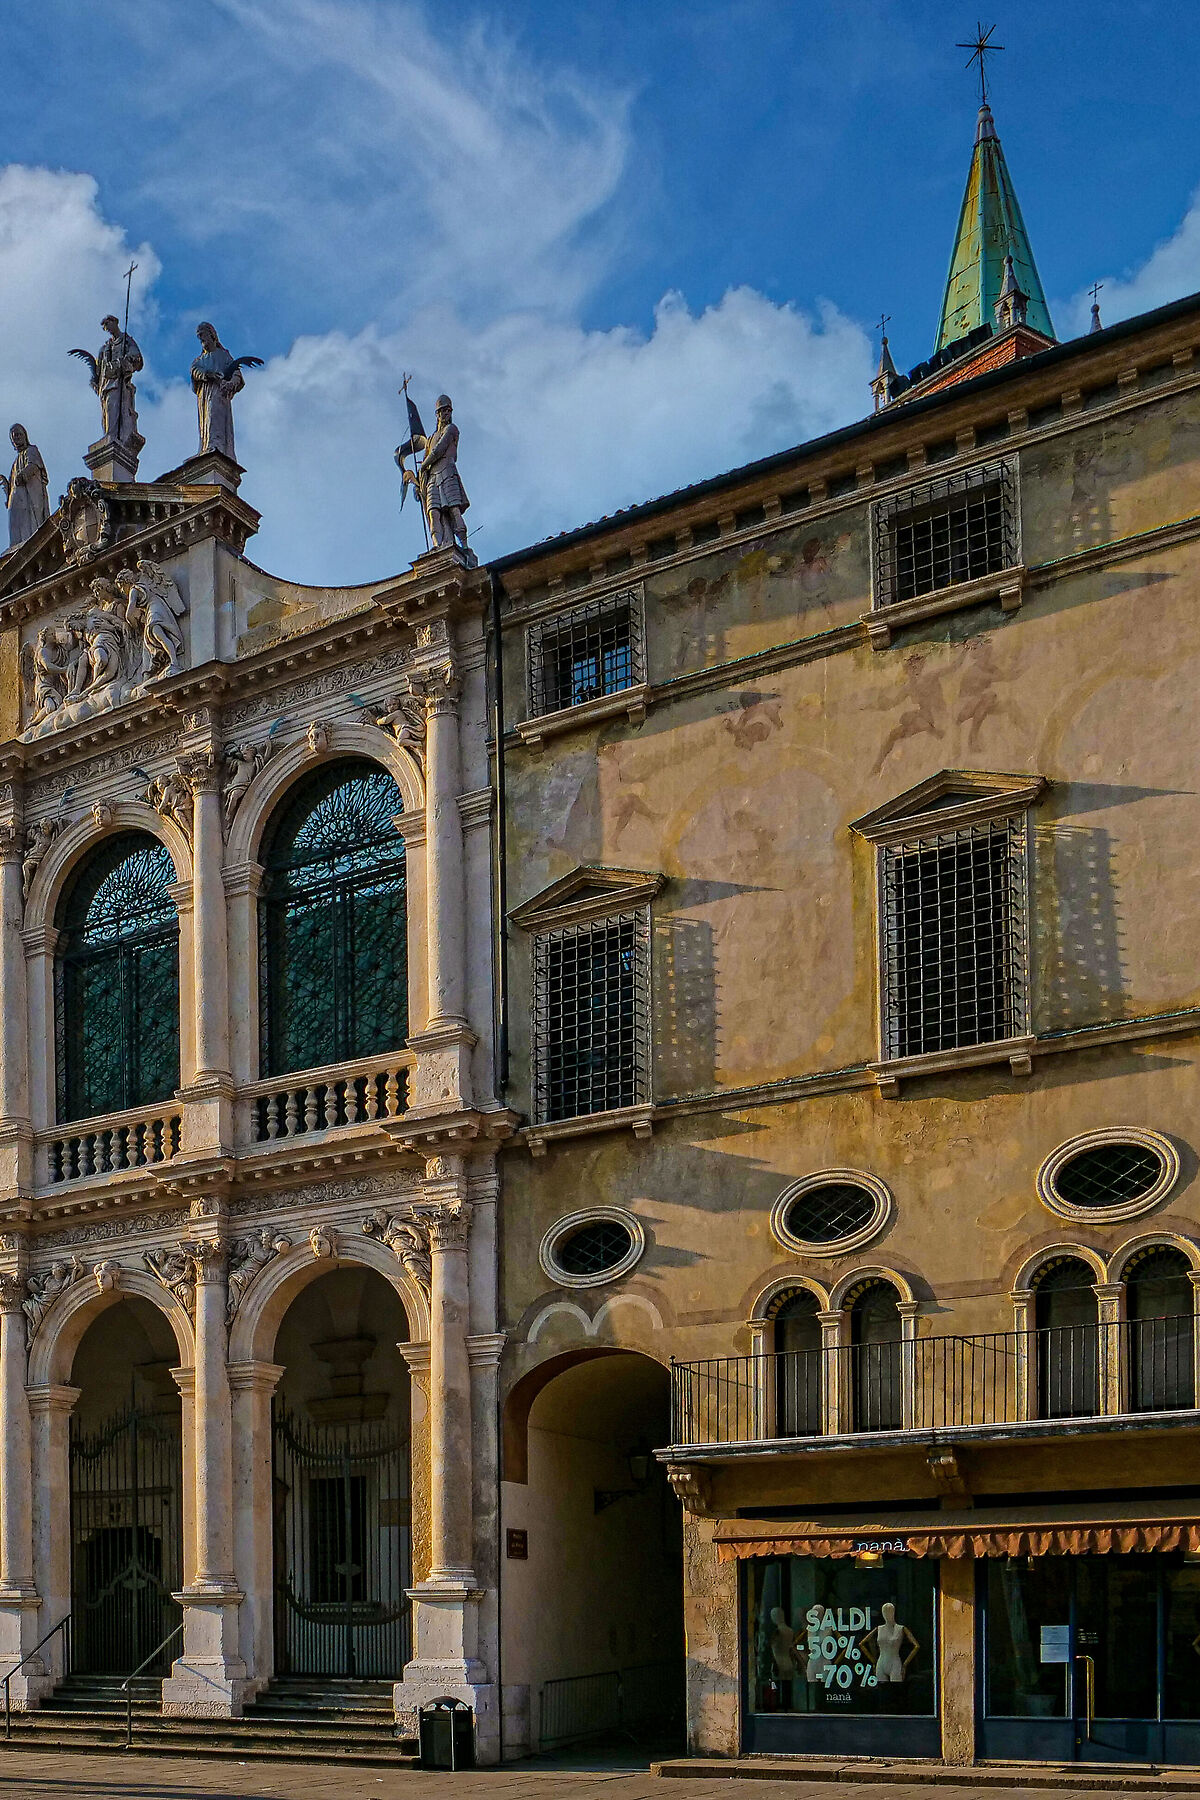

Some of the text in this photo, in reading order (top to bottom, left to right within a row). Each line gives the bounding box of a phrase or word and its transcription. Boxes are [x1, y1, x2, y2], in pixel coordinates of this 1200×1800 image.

[856, 1538, 906, 1553] nanà
[806, 1606, 871, 1632] SALDI
[796, 1635, 861, 1660] -50%
[816, 1662, 878, 1688] -70%
